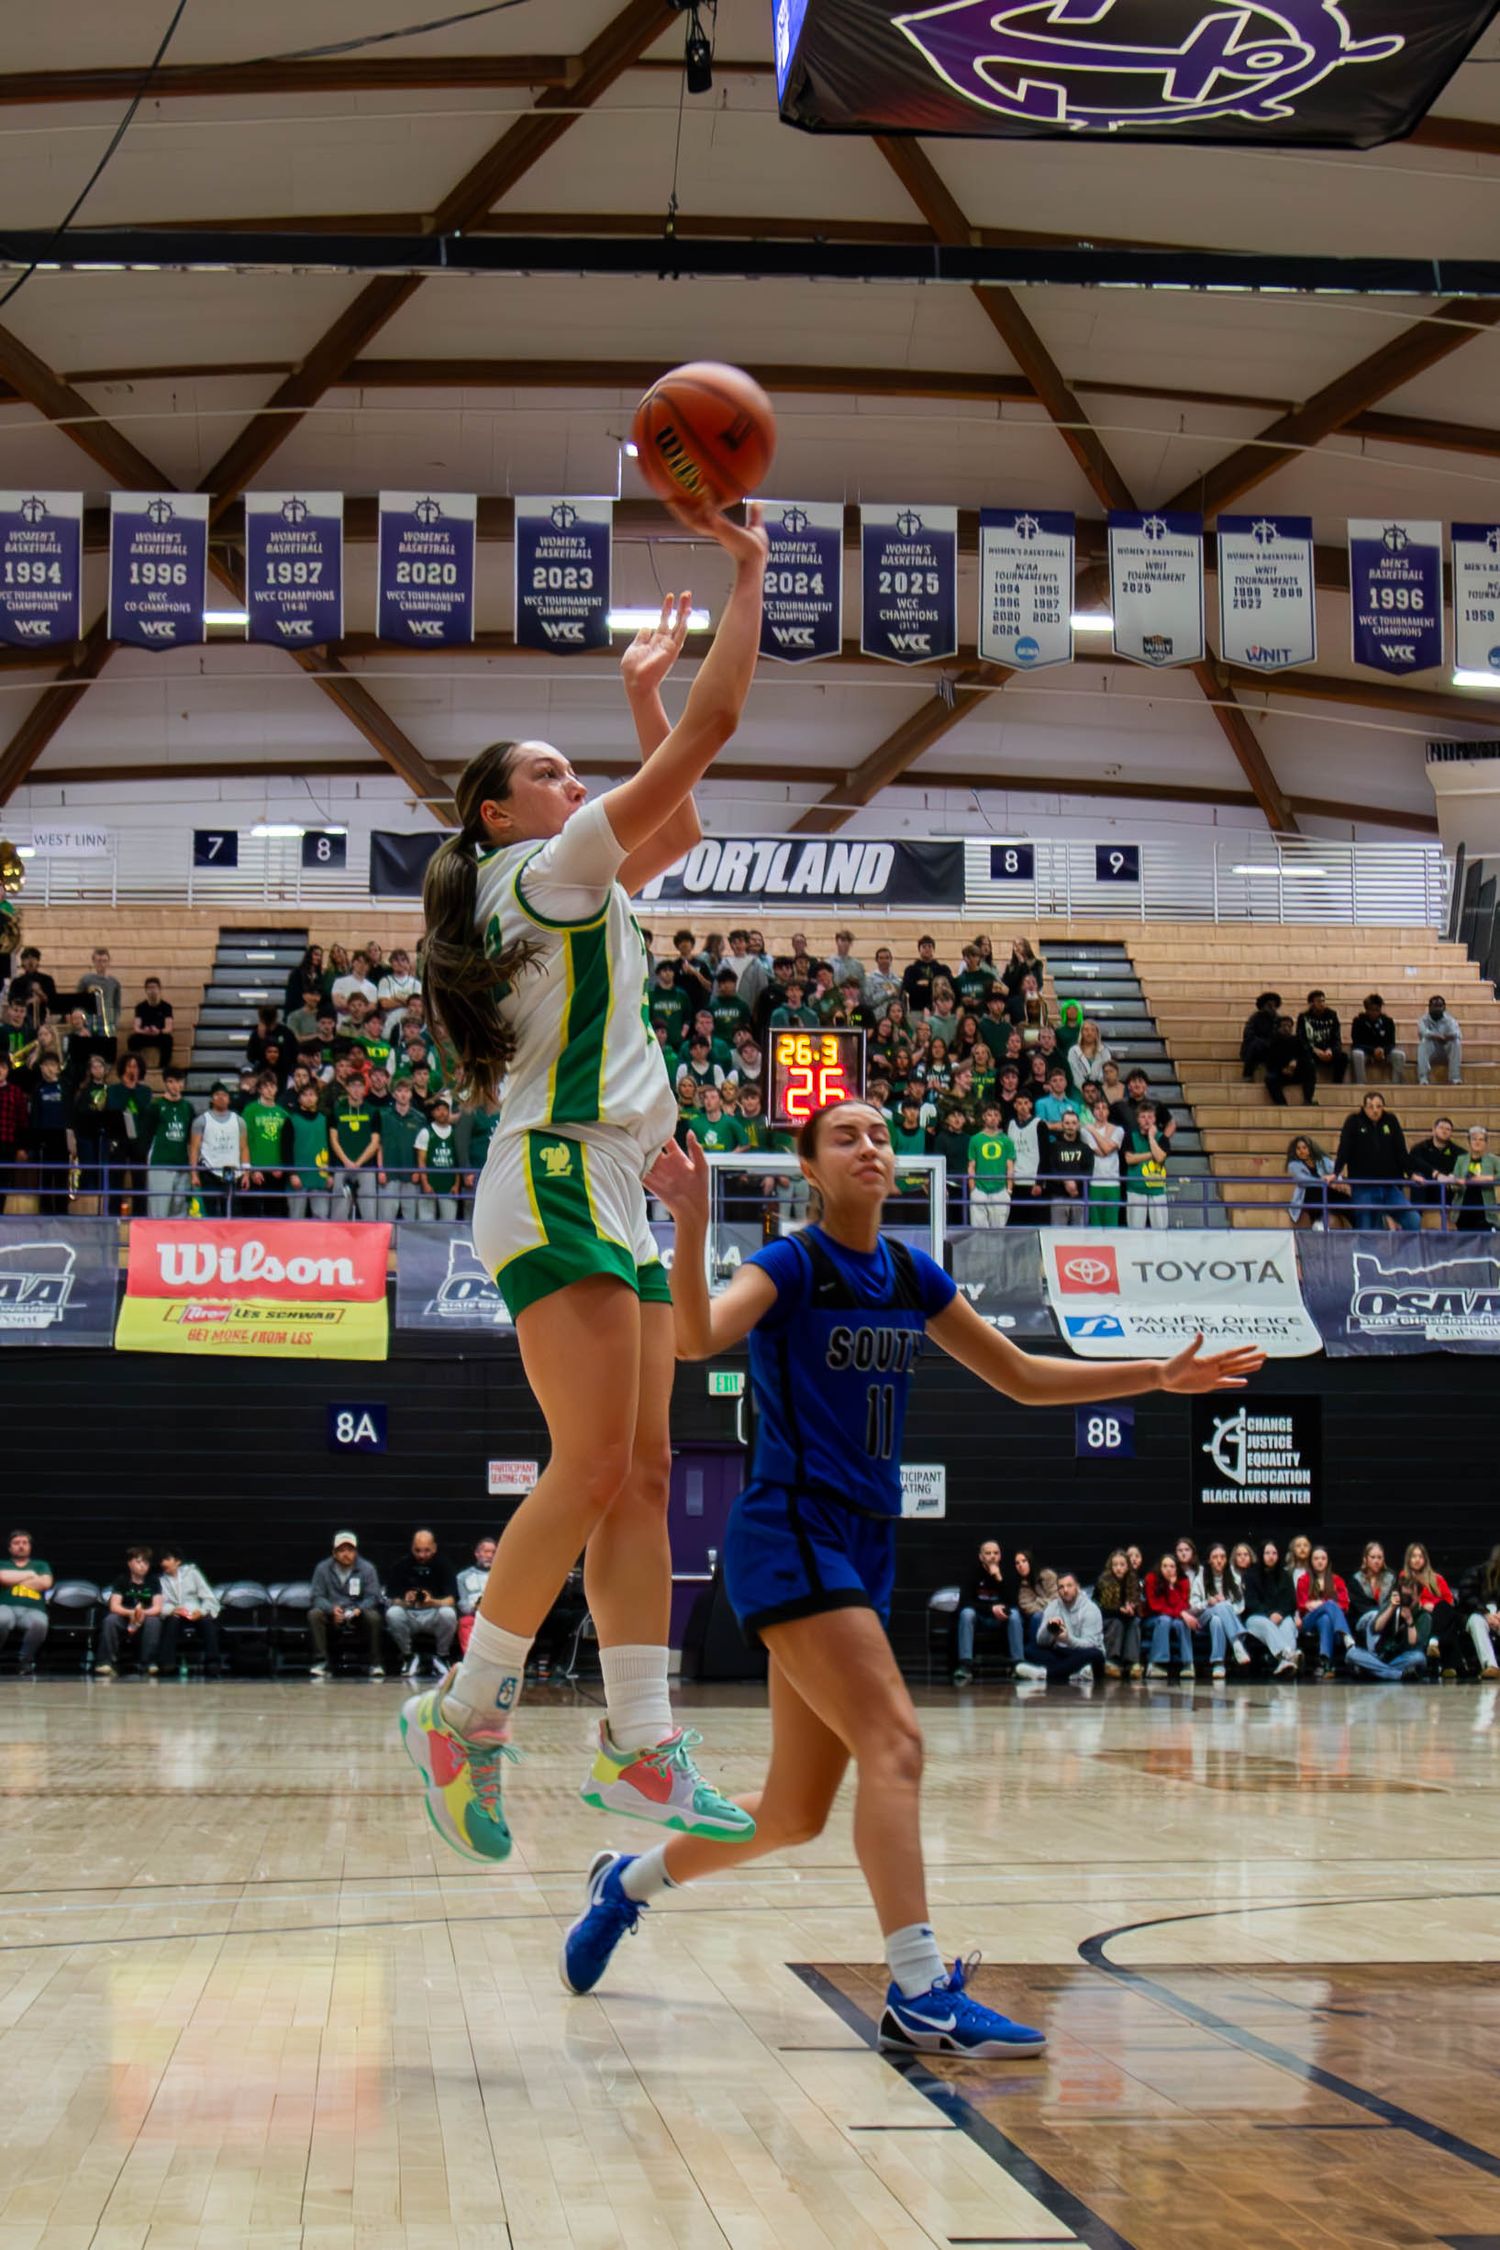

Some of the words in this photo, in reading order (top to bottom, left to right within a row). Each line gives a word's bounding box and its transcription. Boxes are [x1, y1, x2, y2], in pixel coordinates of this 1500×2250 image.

[398, 542, 455, 555] BASKETBALL
[535, 547, 592, 559] BASKETBALL
[886, 544, 932, 555] WOMEN'S
[881, 555, 938, 566] BASKETBALL
[1016, 563, 1038, 571] NCAA
[5, 562, 61, 584] 1994
[130, 562, 187, 585] 1996
[266, 562, 322, 584] 1997
[396, 562, 457, 585] 2020
[533, 567, 593, 590] 2023
[995, 571, 1058, 582] TOURNAMENTS
[1128, 571, 1186, 582] TOURNAMENT
[1368, 569, 1424, 580] BASKETBALL
[764, 571, 824, 595] 2024
[879, 571, 939, 595] 2025
[1122, 582, 1151, 594] 2025
[1235, 576, 1298, 586] TOURNAMENTS
[254, 591, 276, 601] WCC
[277, 590, 335, 601] CHAMPIONS
[386, 591, 406, 601] WCC
[408, 591, 465, 602] TOURNAMENT
[523, 596, 543, 606] WCC
[545, 596, 602, 607] TOURNAMENT
[1370, 587, 1424, 610] 1996
[399, 601, 452, 611] CHAMPIONS
[537, 606, 589, 616] CHAMPIONS
[775, 601, 832, 612] TOURNAMENT
[896, 598, 919, 609] WCC
[768, 611, 819, 622] CHAMPIONS
[879, 609, 938, 620] CHAMPIONS
[1359, 616, 1378, 626] WCC
[1380, 616, 1434, 628] TOURNAMENT
[15, 620, 51, 636] WCC
[139, 621, 176, 636] WCC
[276, 620, 313, 636] WCC
[407, 620, 444, 636] WCC
[541, 622, 585, 639] WCC
[771, 626, 815, 644] WCC
[1372, 627, 1422, 637] CHAMPIONS
[887, 633, 931, 650] WCC
[1245, 647, 1292, 662] WNIT
[1380, 644, 1416, 661] WCC
[34, 834, 70, 847] WEST
[76, 834, 107, 847] LINN
[208, 837, 224, 859] 7
[316, 838, 331, 861] 8
[1005, 850, 1018, 873] 8
[1109, 852, 1124, 874] 9
[776, 1034, 838, 1066] 26.3
[1060, 1151, 1082, 1163] 1977
[156, 1241, 356, 1286] Wilson
[1131, 1260, 1284, 1284] TOYOTA
[1351, 1286, 1500, 1318] OSAA
[234, 1308, 260, 1319] LES
[265, 1310, 336, 1321] SCHWAB
[1129, 1315, 1211, 1326] PACIFIC
[1222, 1316, 1303, 1326] OFFICE
[291, 1332, 313, 1345] LES
[1136, 1326, 1288, 1336] AUTOMATION
[716, 1375, 739, 1393] EXIT
[337, 1412, 378, 1444] 8A
[866, 1384, 895, 1460] 11
[1247, 1417, 1293, 1432] CHANGE
[1087, 1417, 1122, 1448] 8B
[1247, 1435, 1293, 1450] JUSTICE
[1247, 1452, 1300, 1467] EQUALITY
[901, 1471, 942, 1483] TICIPANT
[1247, 1470, 1311, 1484] EDUCATION
[903, 1483, 931, 1495] ATING
[1202, 1489, 1237, 1504] BLACK
[1239, 1489, 1267, 1504] LIVES
[1270, 1490, 1311, 1504] MATTER
